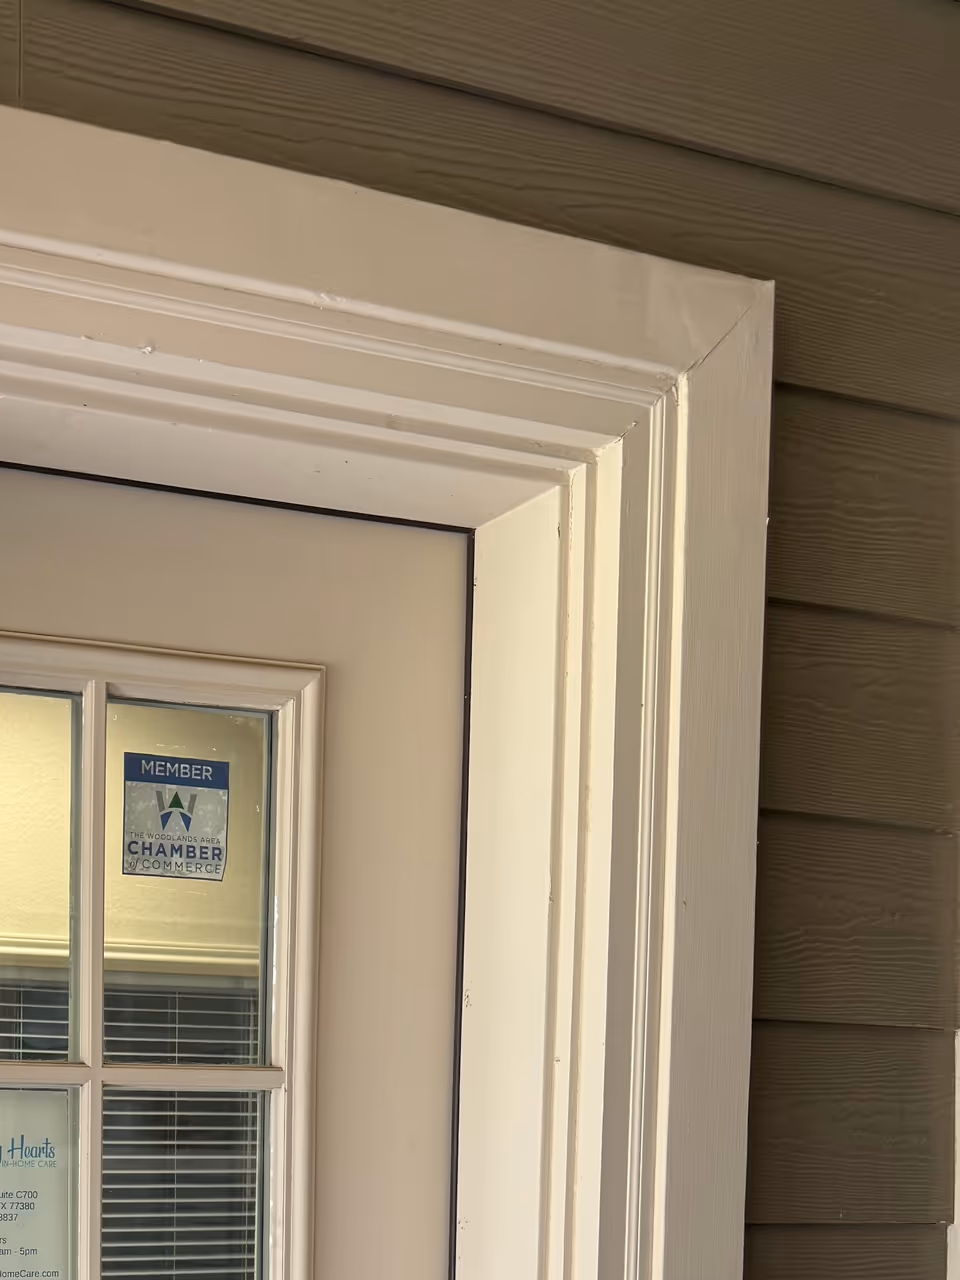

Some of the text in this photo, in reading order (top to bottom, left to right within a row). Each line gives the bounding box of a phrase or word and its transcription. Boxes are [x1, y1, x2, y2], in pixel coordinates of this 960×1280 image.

[141, 759, 213, 780] MEMBER
[130, 831, 221, 845] THE WOODLANDS AREA
[127, 840, 222, 861] CHAMBER
[129, 858, 222, 874] of COMMERCE
[8, 1135, 55, 1159] Hearts
[2, 1160, 57, 1168] IN-HOME CARE
[15, 1191, 38, 1199] C700
[9, 1202, 35, 1210] 77380
[20, 1247, 38, 1256] 5pm
